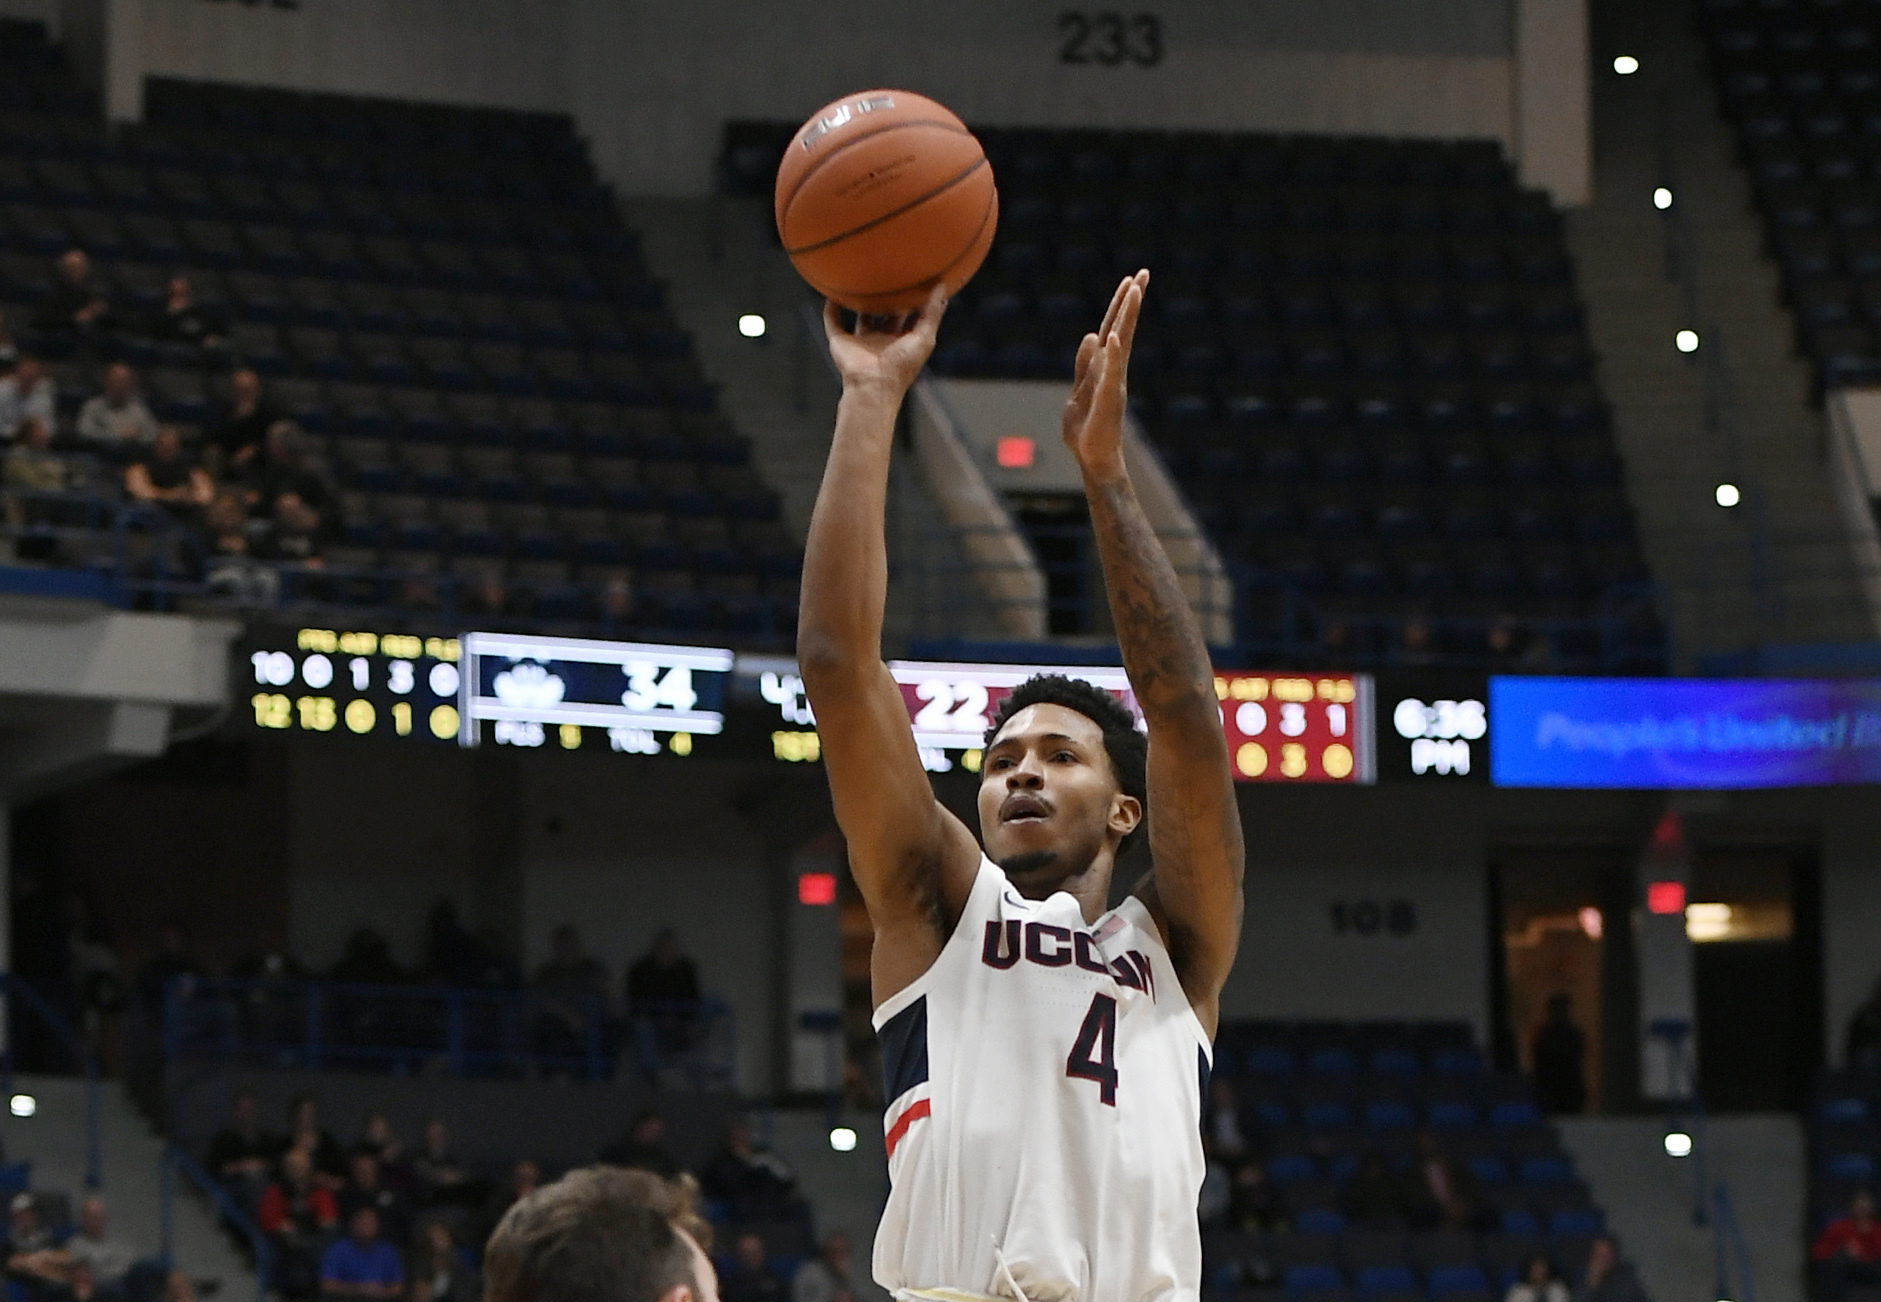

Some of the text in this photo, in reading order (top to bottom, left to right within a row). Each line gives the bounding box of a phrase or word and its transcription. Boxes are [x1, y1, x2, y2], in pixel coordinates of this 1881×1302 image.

[1056, 11, 1165, 67] 233
[620, 659, 698, 713] 34
[914, 678, 990, 731] 22
[1065, 990, 1119, 1107] 4
